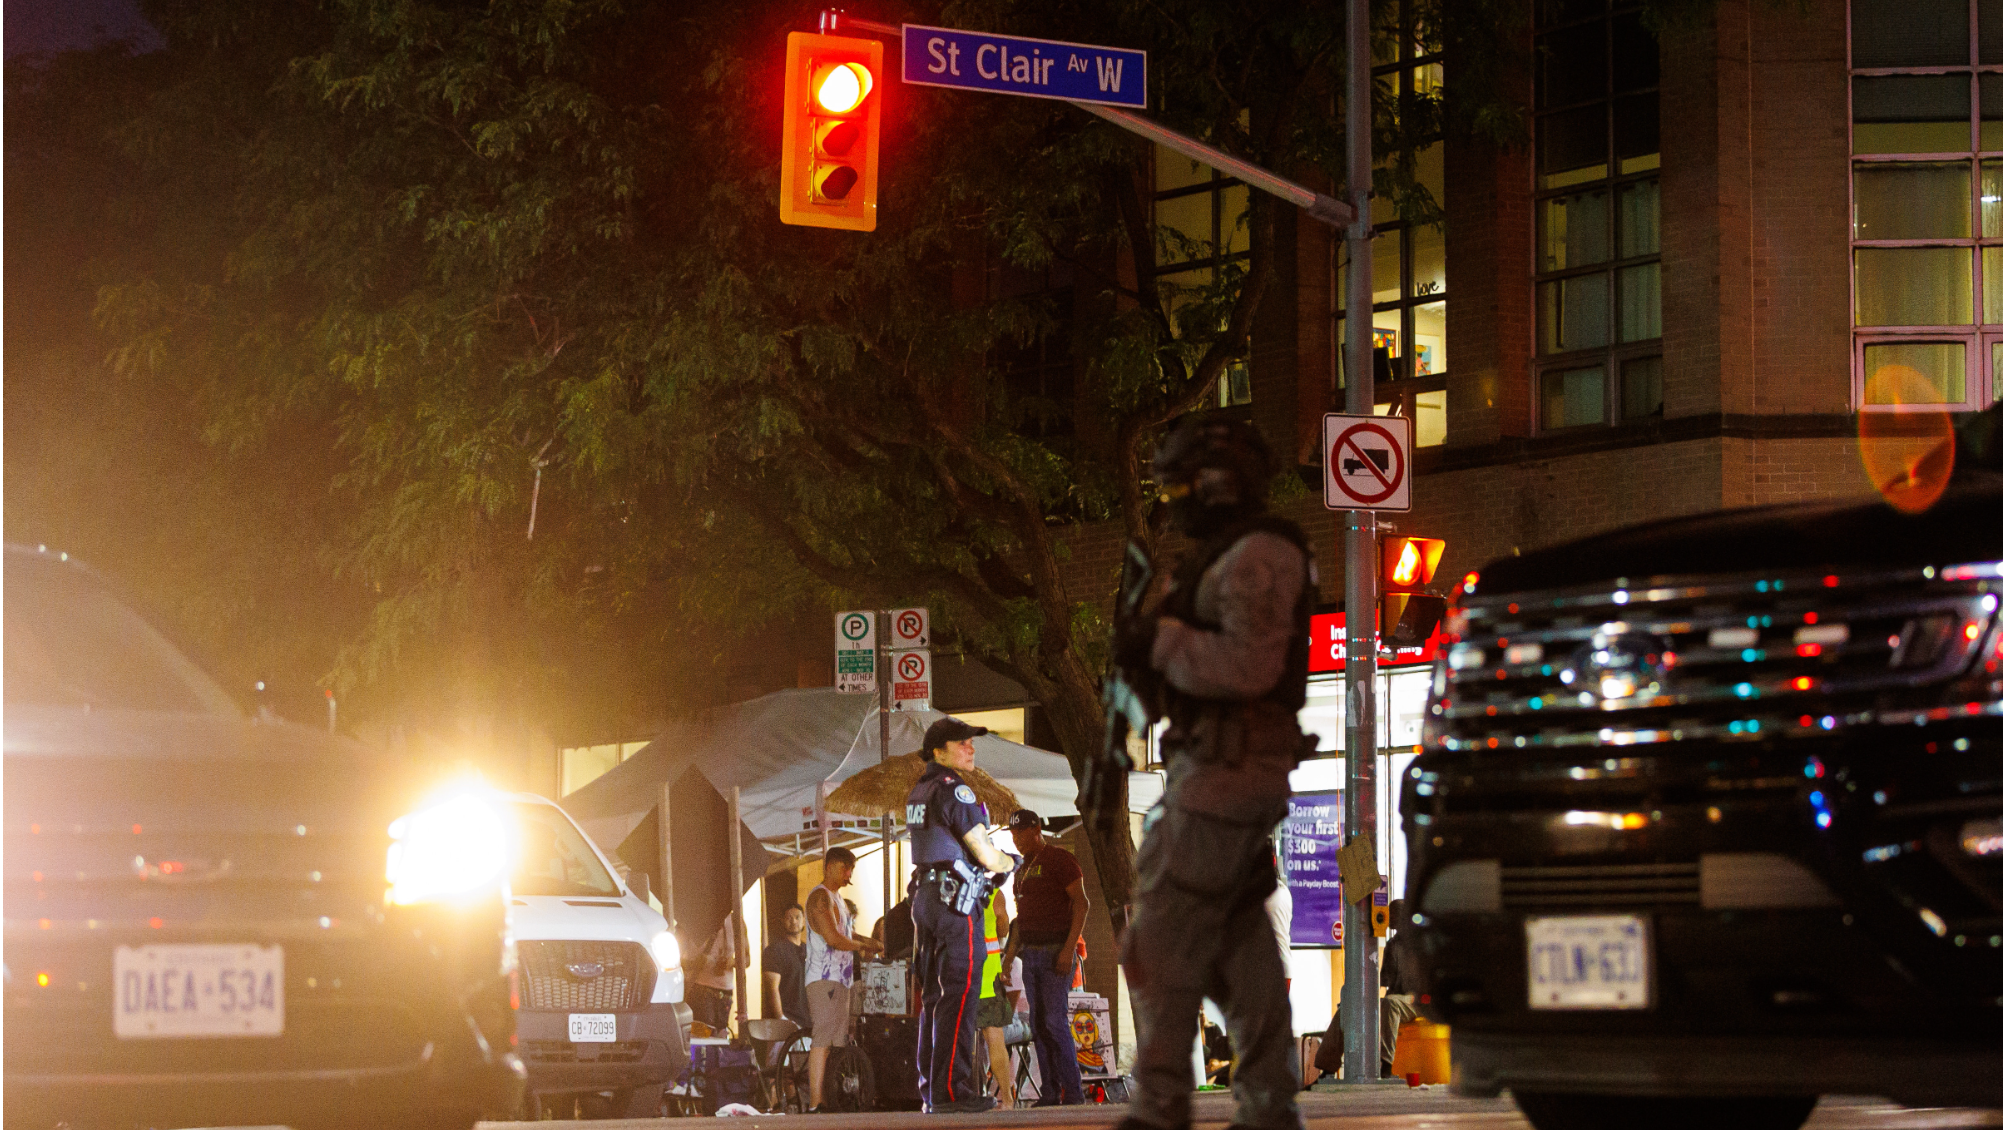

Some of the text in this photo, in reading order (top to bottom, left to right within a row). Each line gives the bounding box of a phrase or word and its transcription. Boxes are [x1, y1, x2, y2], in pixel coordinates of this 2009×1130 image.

[927, 37, 1123, 93] St Clair Av W
[850, 620, 862, 635] P
[841, 673, 873, 682] AT OTHER
[847, 683, 867, 692] TIMES
[1288, 802, 1330, 818] Borrow
[1287, 819, 1339, 837] your first
[1287, 838, 1316, 855] $300
[1286, 859, 1302, 871] on
